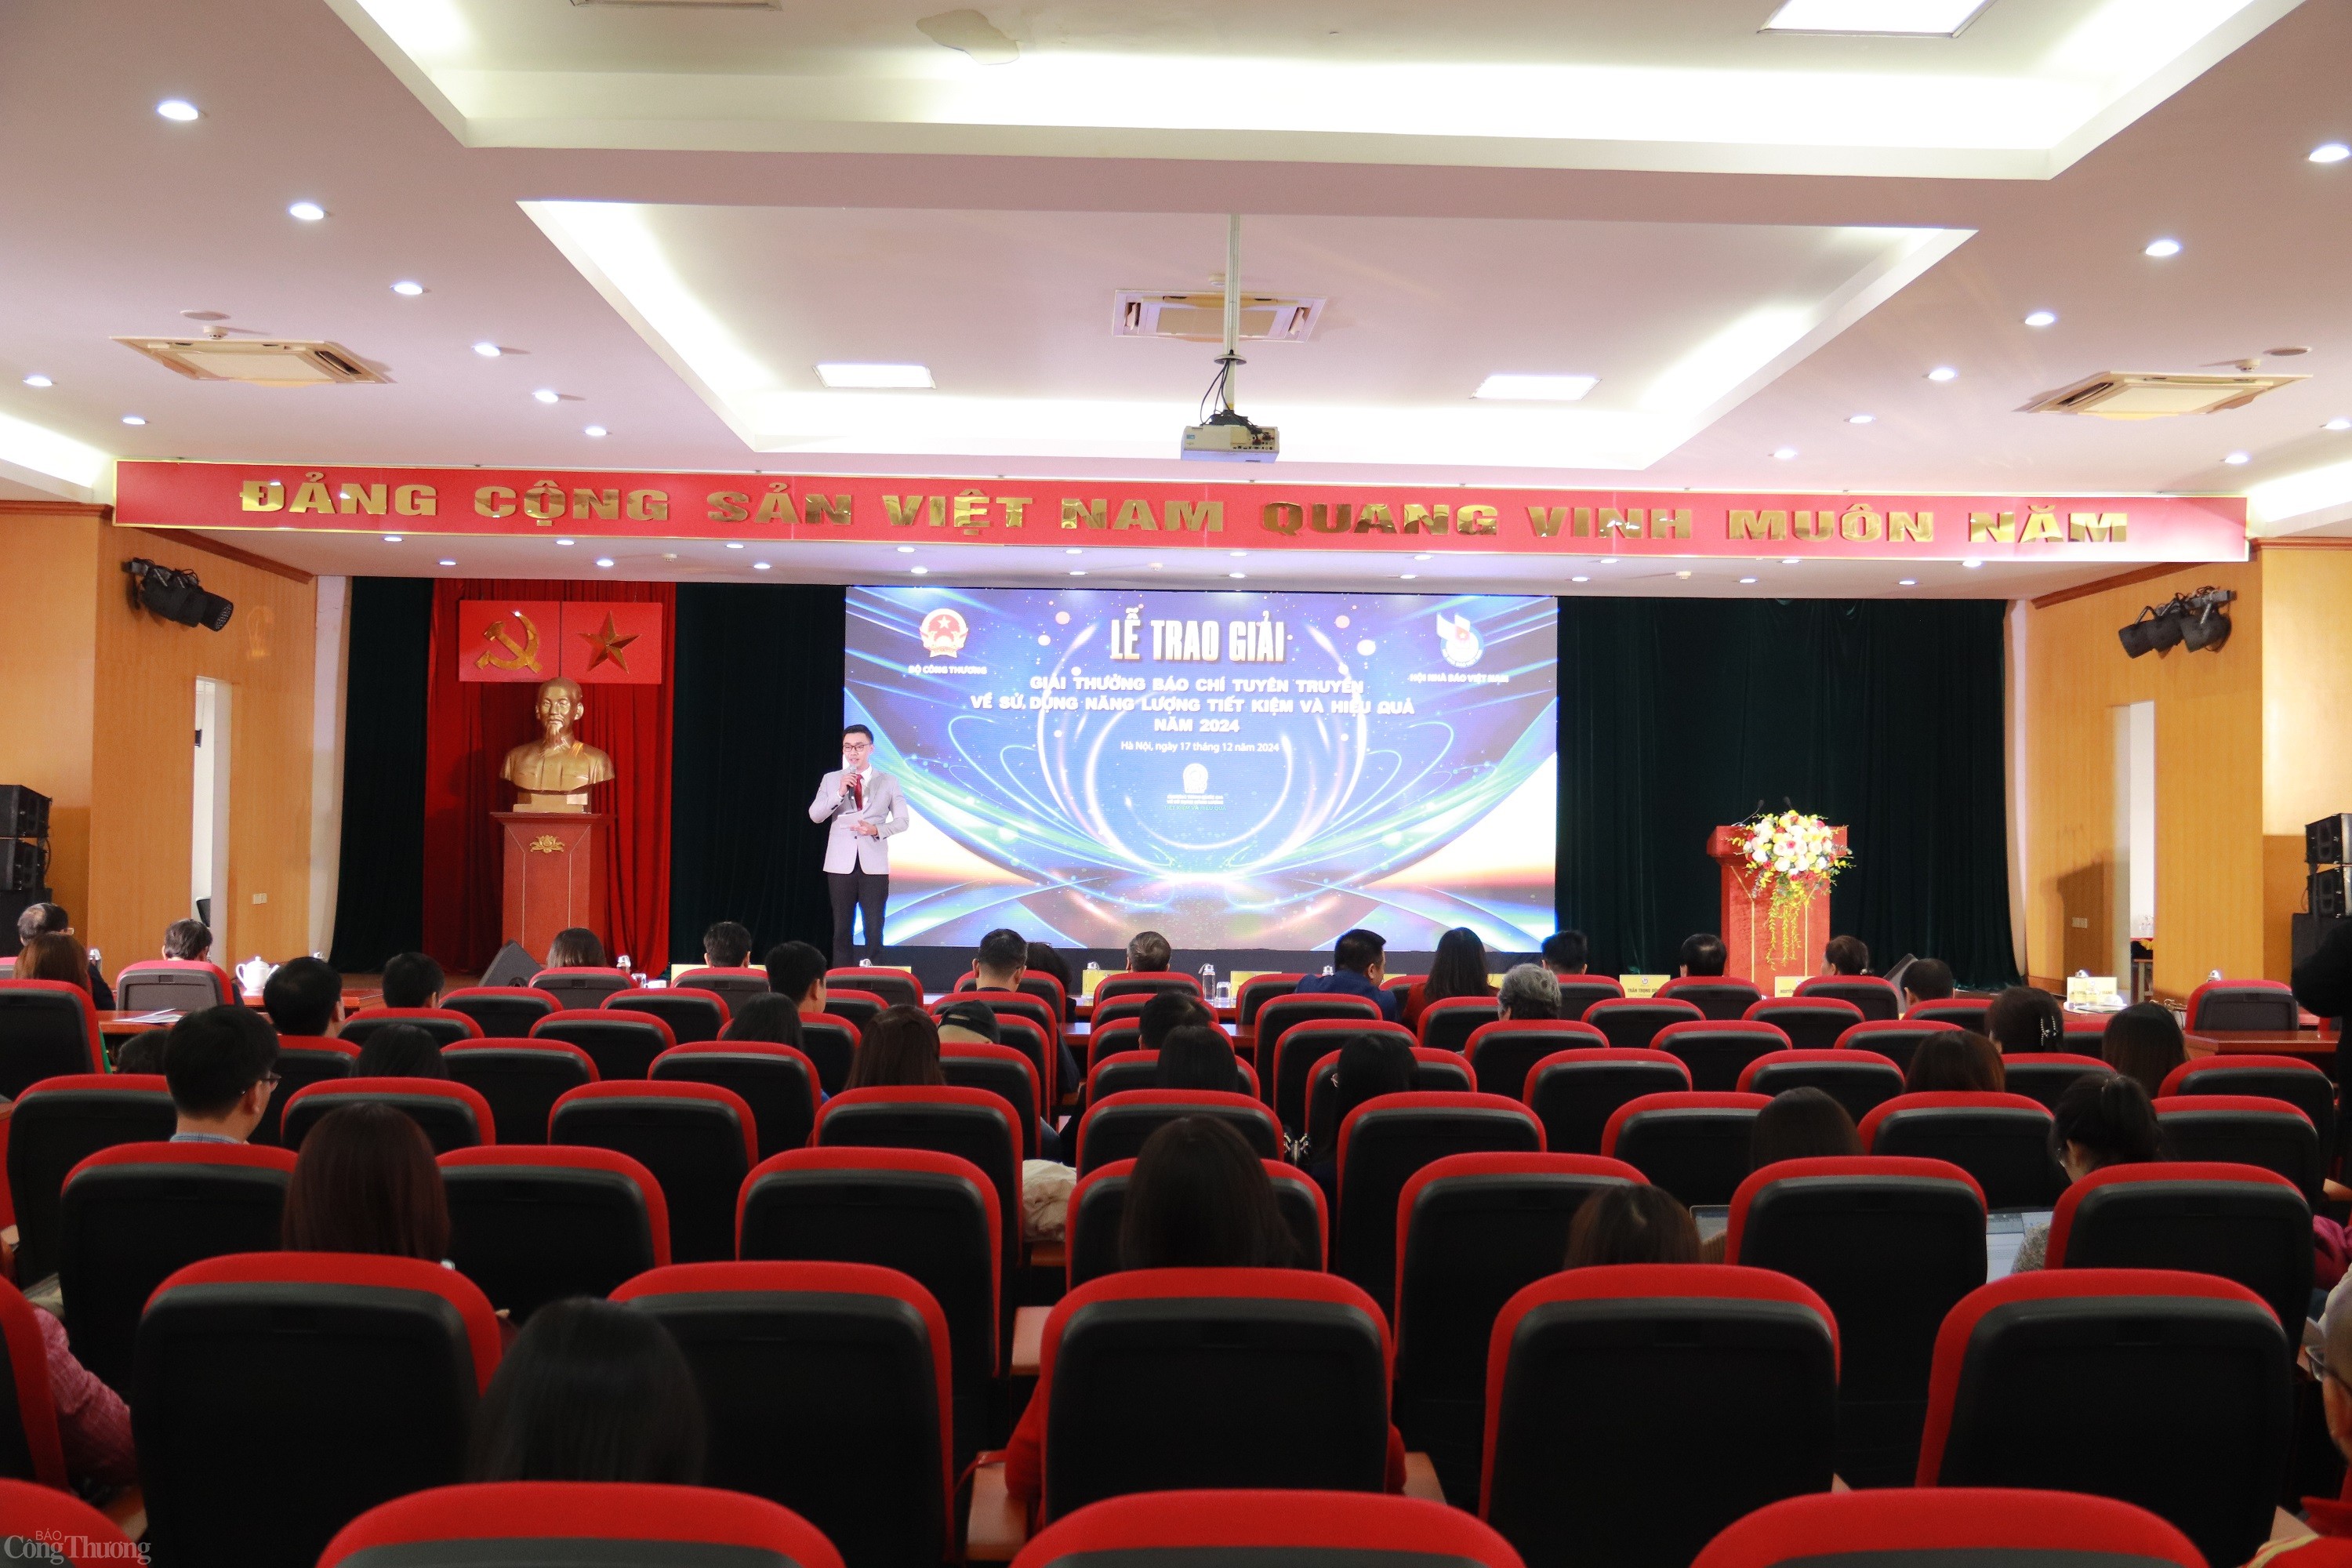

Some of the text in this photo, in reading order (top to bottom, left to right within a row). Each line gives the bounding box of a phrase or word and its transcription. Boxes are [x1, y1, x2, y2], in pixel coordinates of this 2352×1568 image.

[239, 472, 2128, 543] ĐẢNG CỘNG SẢN VIỆT NAM QUANG VINH MUÔN NĂM
[1109, 607, 1284, 662] LỄ TRAO GIẢI
[1073, 673, 1146, 691] THƯỞNG
[1152, 675, 1189, 691] BÁO
[1196, 676, 1225, 692] CHÍ
[1232, 677, 1289, 693] TUYÊN
[1295, 675, 1364, 694] TRUYỀN
[970, 691, 993, 710] VỀ
[1029, 696, 1079, 713] DỤNG
[1085, 695, 1135, 710] NĂNG
[1142, 697, 1201, 714] LƯỢNG
[1207, 695, 1245, 713] TIẾT
[1251, 696, 1294, 716] KIỆM
[1300, 697, 1325, 713] VÀ
[1331, 698, 1371, 717] HIỆU
[1377, 697, 1415, 715] QUẢ
[1154, 716, 1240, 732] NĂM 2024
[1121, 741, 1133, 750] Hà
[1156, 742, 1178, 753] ngày
[1181, 742, 1190, 751] 17
[1192, 742, 1220, 753] tháng
[1235, 742, 1255, 752] năm
[1257, 743, 1279, 752] 2024
